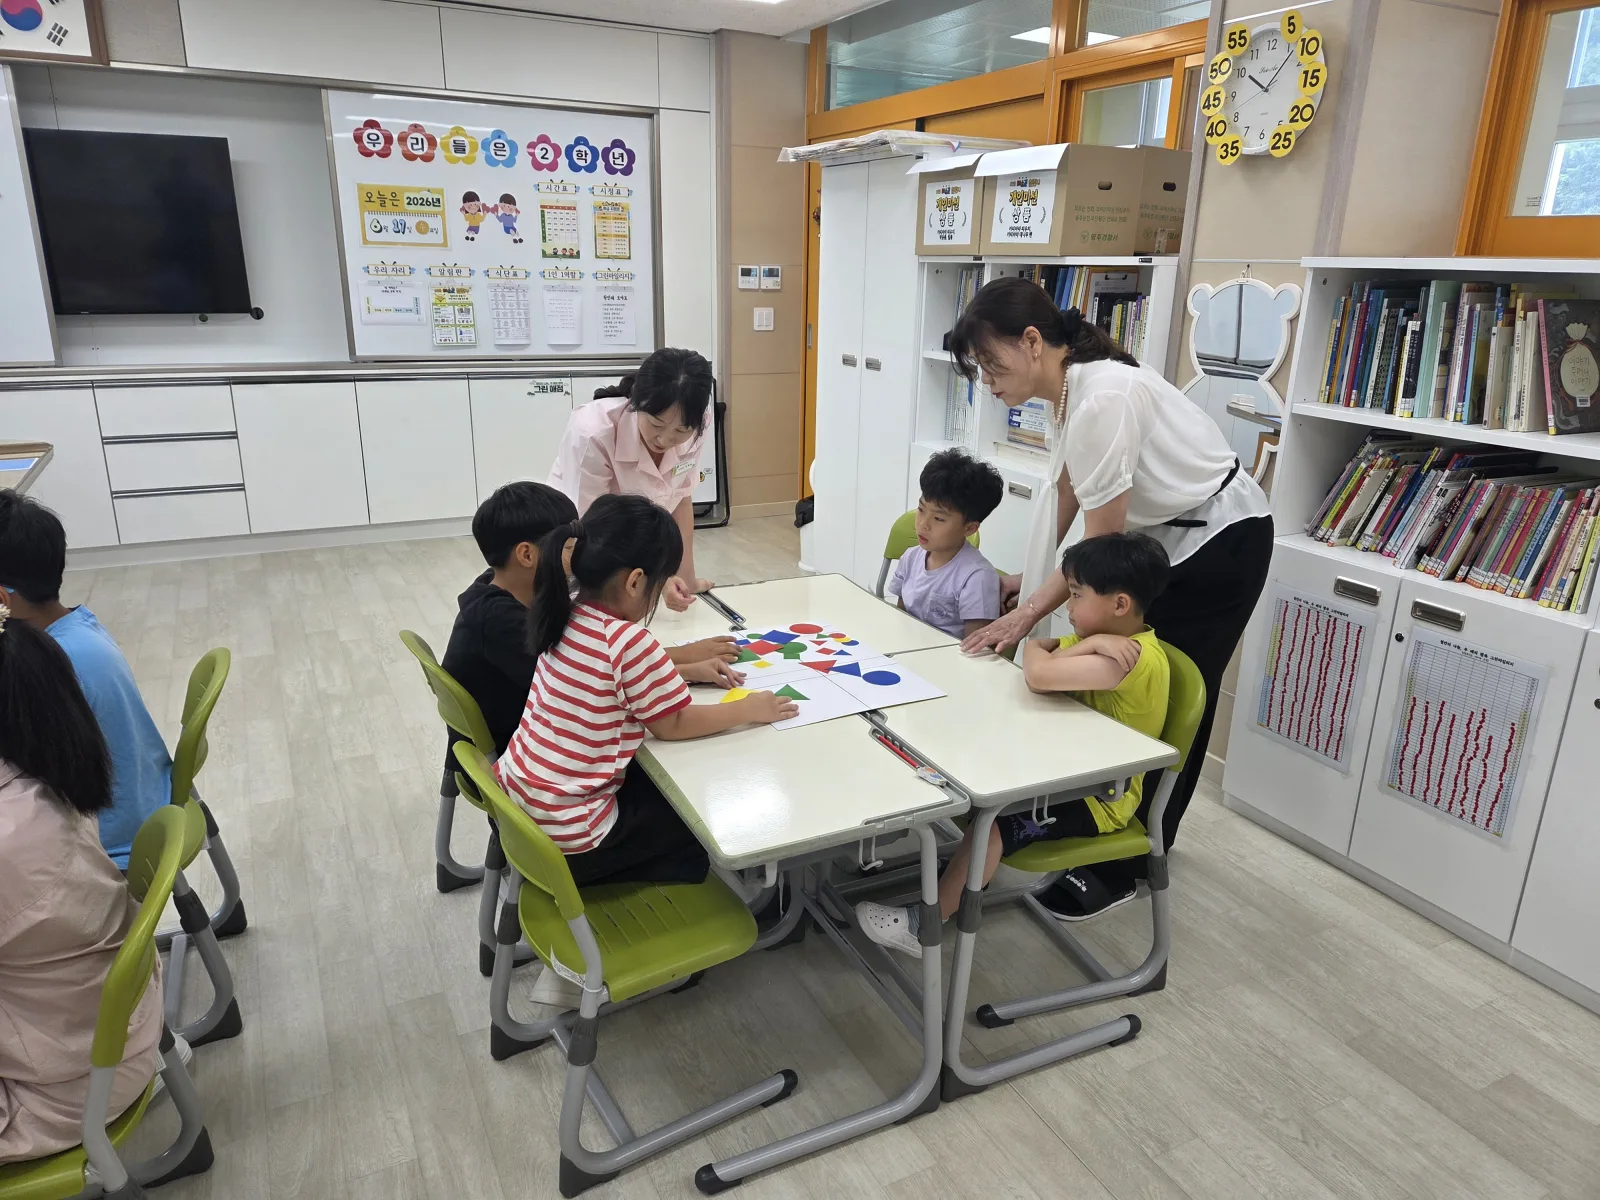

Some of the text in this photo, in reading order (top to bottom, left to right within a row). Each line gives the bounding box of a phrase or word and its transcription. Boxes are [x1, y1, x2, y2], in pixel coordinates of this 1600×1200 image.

[1287, 15, 1296, 35] 5
[1227, 29, 1248, 50] 55
[1267, 38, 1278, 51] 12
[1300, 36, 1320, 57] 10
[1250, 48, 1259, 61] 11
[1209, 57, 1232, 80] 50
[1236, 67, 1247, 79] 10
[1302, 68, 1321, 88] 15
[1202, 90, 1221, 111] 45
[1230, 91, 1237, 102] 9
[1233, 112, 1239, 123] 8
[1289, 103, 1315, 123] 20
[1205, 119, 1227, 139] 40
[1244, 126, 1250, 137] 7
[1259, 129, 1265, 140] 6
[1270, 131, 1293, 151] 25
[366, 132, 625, 167] 우리들은 2학년
[1219, 139, 1240, 160] 35
[545, 184, 569, 192] 시간표
[600, 187, 622, 196] 시정표
[364, 190, 442, 208] 오늘은 2026년
[936, 195, 960, 212] 개인미션
[1009, 188, 1039, 207] 개인미션
[373, 266, 406, 276] 우리 자리
[438, 267, 463, 276] 알림판
[548, 271, 558, 279] 1인
[597, 272, 631, 281] 그린마일리지
[1568, 355, 1590, 366] 이야기
[1571, 366, 1590, 377] 주머니
[1570, 377, 1591, 386] 이야기
[533, 385, 549, 394] 그린
